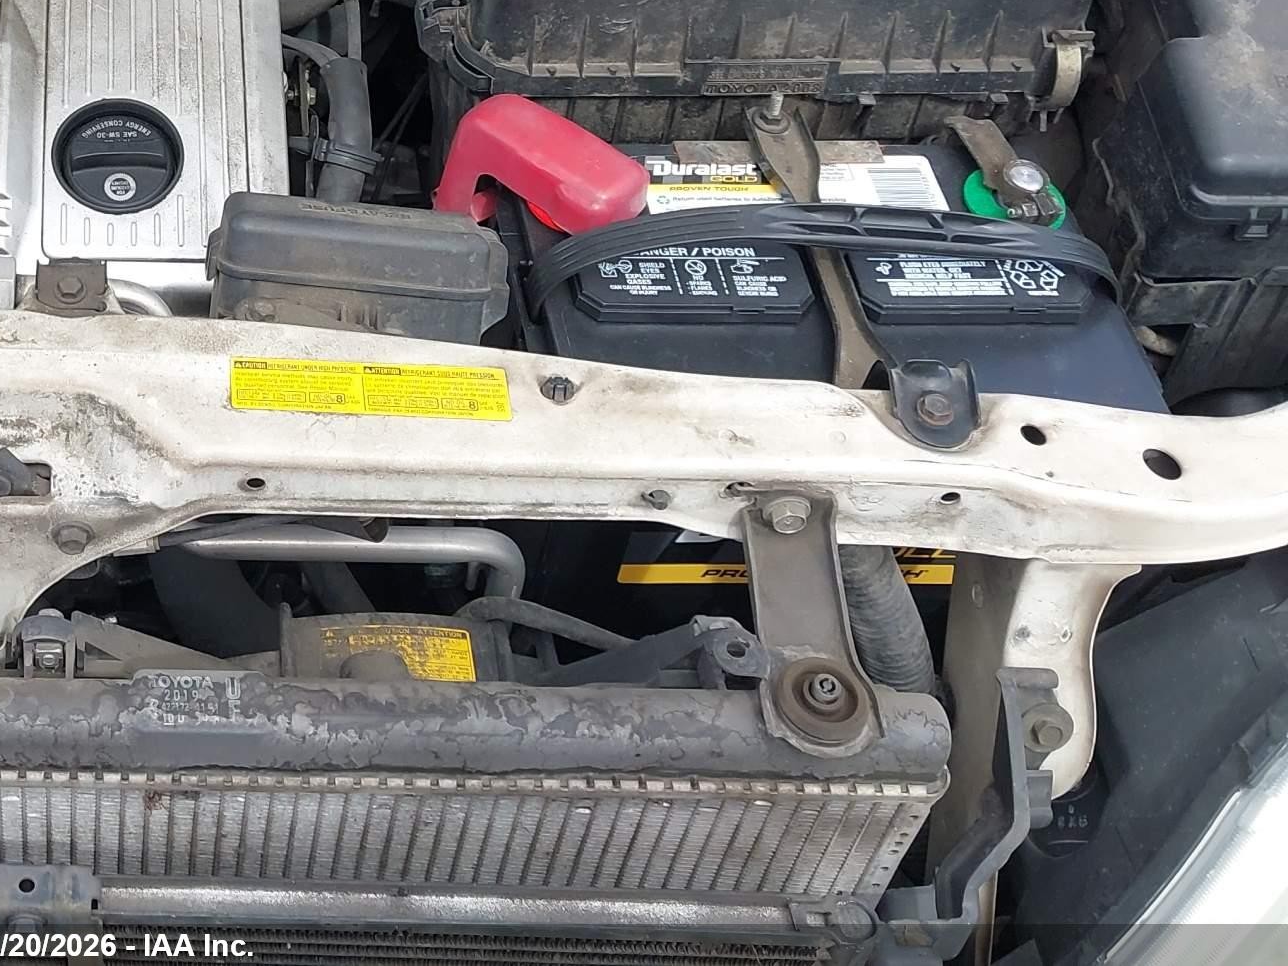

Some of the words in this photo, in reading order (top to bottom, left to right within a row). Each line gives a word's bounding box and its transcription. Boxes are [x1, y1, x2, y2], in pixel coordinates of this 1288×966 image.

[81, 119, 123, 138] CONSERVING
[125, 121, 152, 136] ENERGY
[646, 160, 758, 176] Duralast
[702, 248, 756, 256] POISON
[151, 675, 214, 689] TOYOTA
